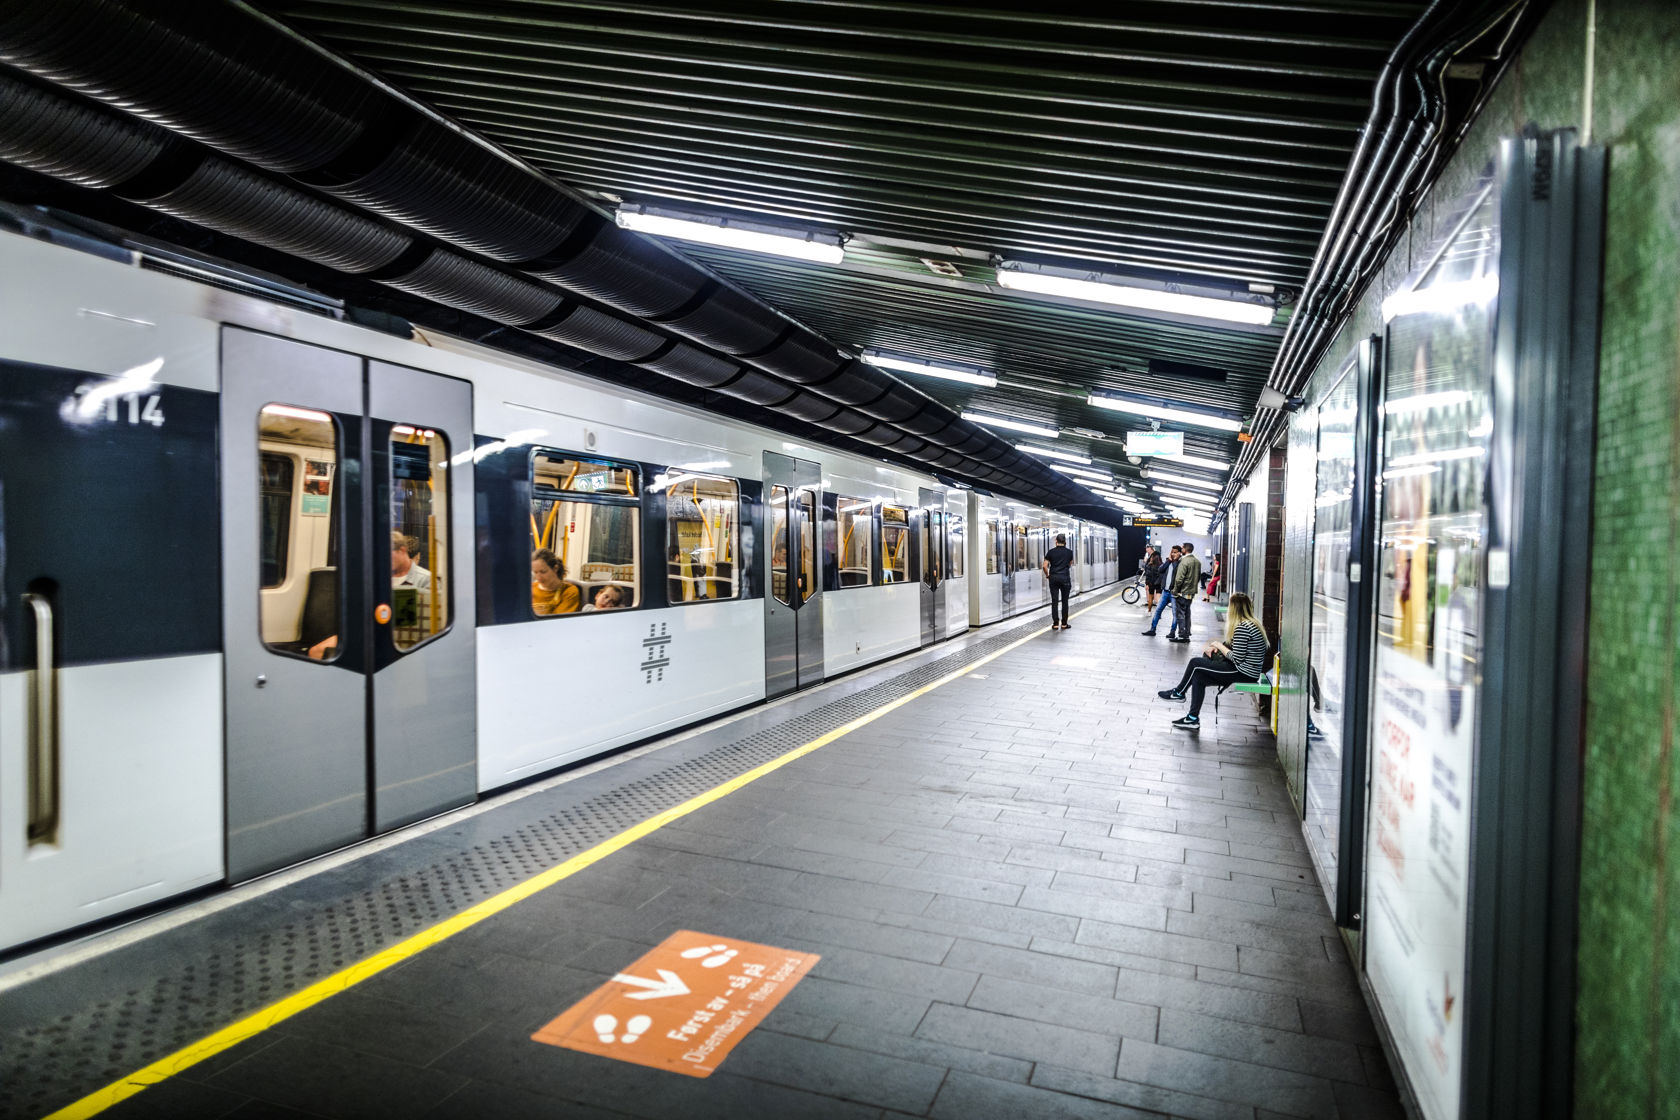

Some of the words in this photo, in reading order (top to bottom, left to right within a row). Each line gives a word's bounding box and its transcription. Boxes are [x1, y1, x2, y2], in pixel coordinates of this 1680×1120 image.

[666, 1010, 716, 1041] Først
[706, 995, 729, 1011] av
[728, 975, 752, 989] så
[742, 962, 766, 978] på
[682, 1009, 752, 1064] Disembark
[748, 981, 779, 1001] then
[766, 957, 802, 982] board
